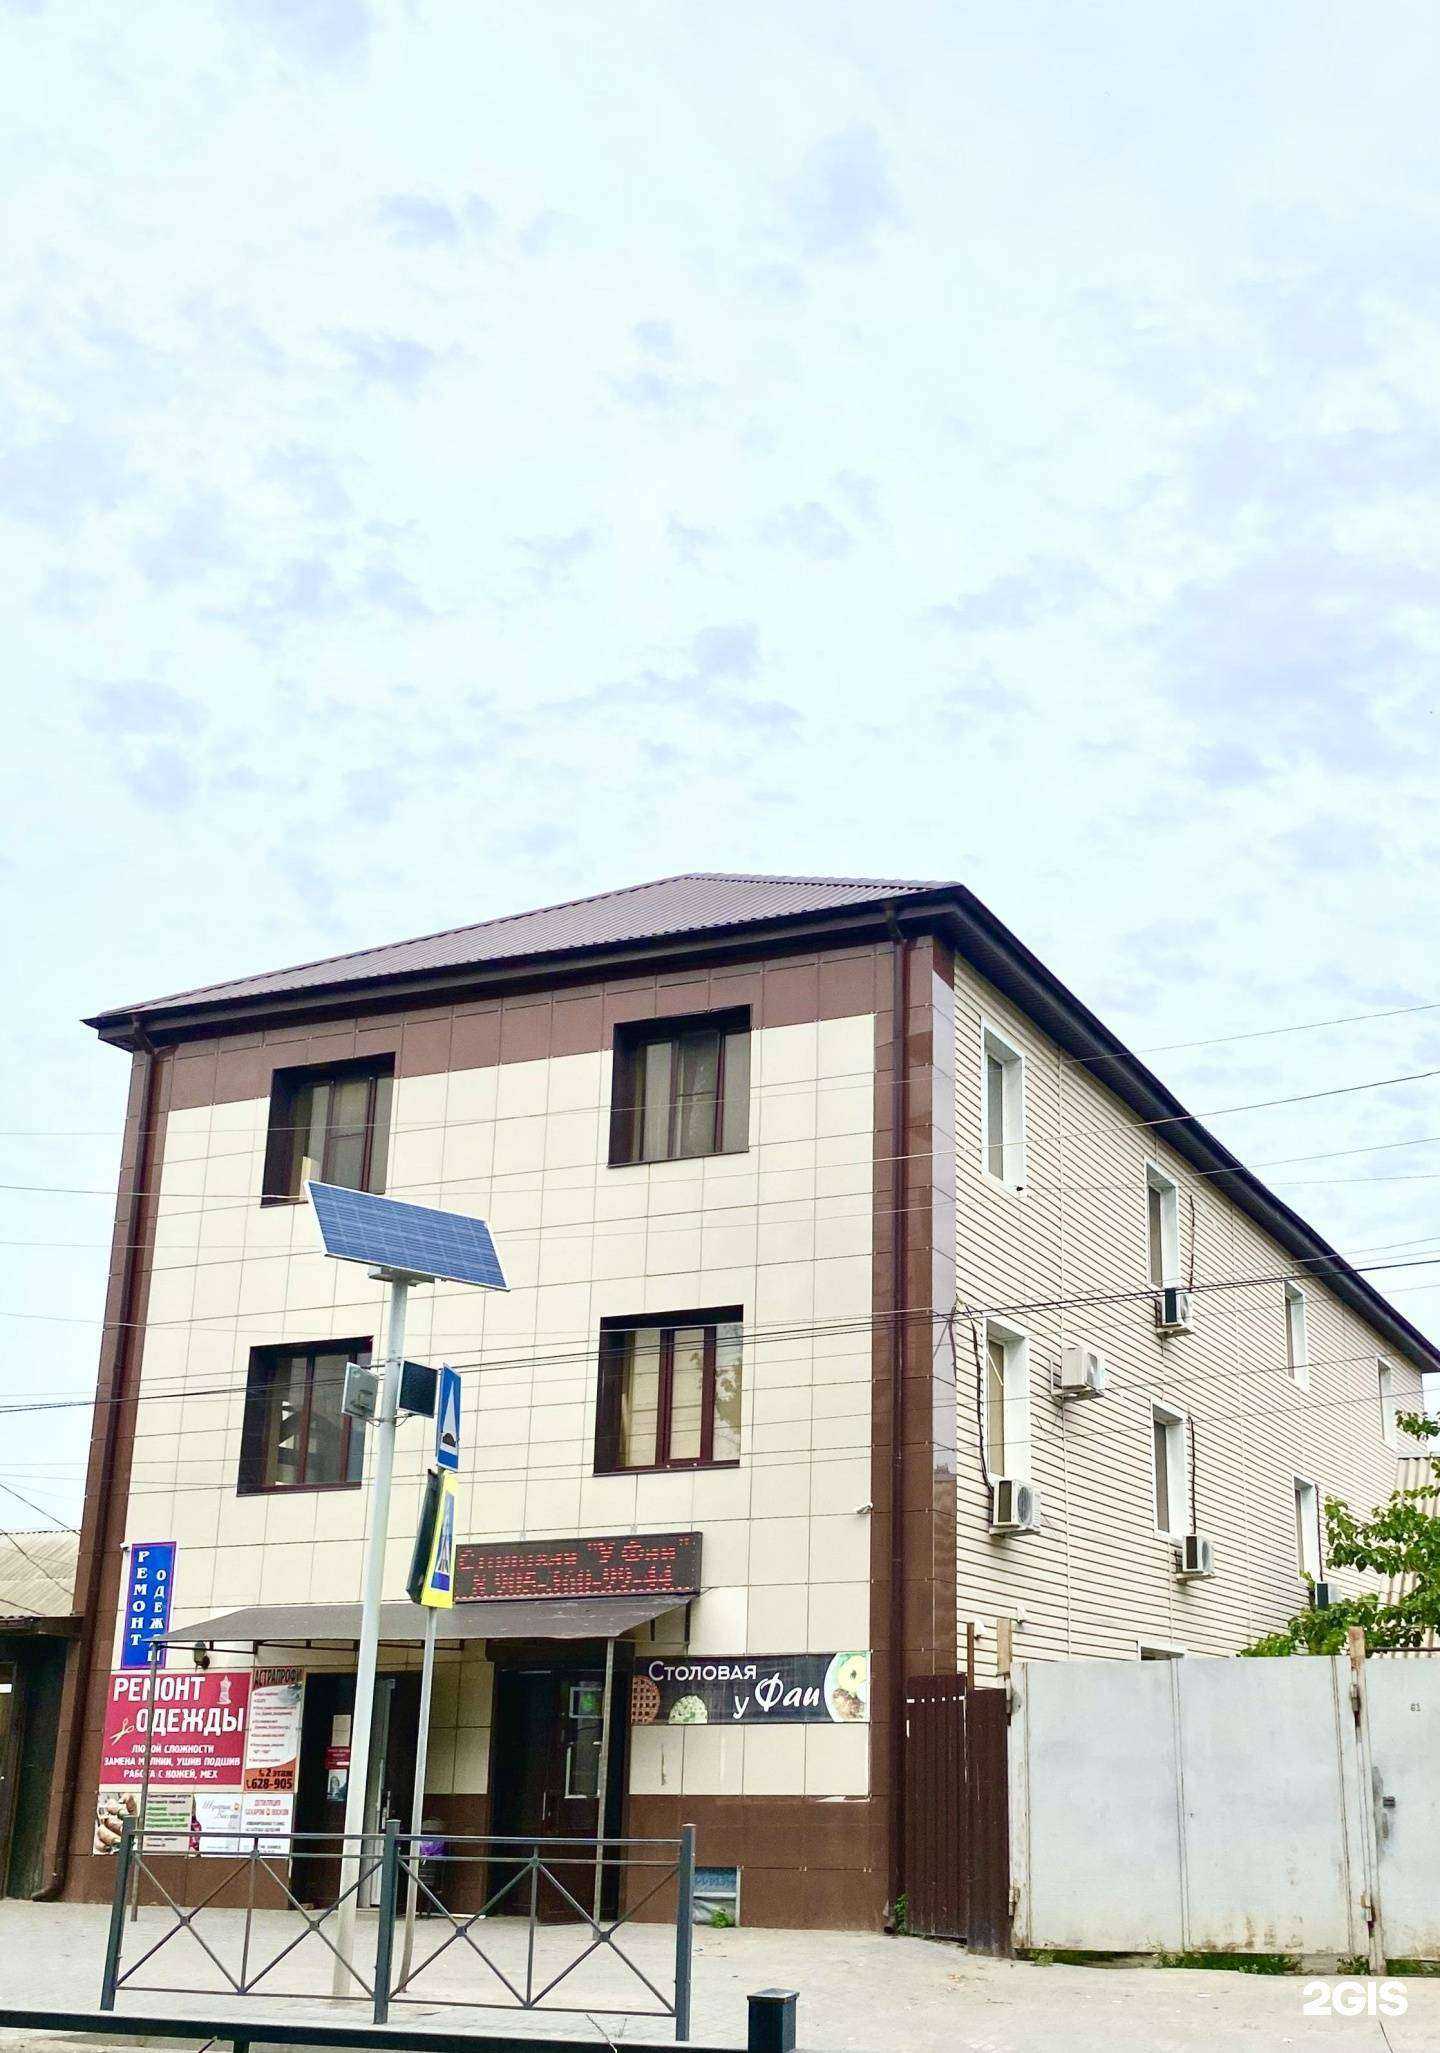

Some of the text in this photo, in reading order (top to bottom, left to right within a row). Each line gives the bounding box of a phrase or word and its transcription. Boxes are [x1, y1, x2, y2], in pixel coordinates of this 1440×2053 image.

[130, 1550, 150, 1646] РЕМОНТ
[147, 1569, 167, 1662] ОДЕЖЫ
[113, 1676, 206, 1702] РЕМОНТ
[755, 1672, 821, 1712] Фаи
[136, 1707, 244, 1736] ОДЕЖДЫ
[131, 1744, 215, 1754] ЛЮОЙ СЛОЖНОСТИ
[104, 1757, 136, 1766] ЗАМЕНА
[138, 1757, 174, 1767] МЛНИИ,
[176, 1757, 202, 1766] УШИВ
[204, 1757, 241, 1766] ПОДШИВ
[200, 1769, 218, 1778] МЕХ
[265, 1767, 271, 1777] 2
[251, 1778, 293, 1790] 628-905
